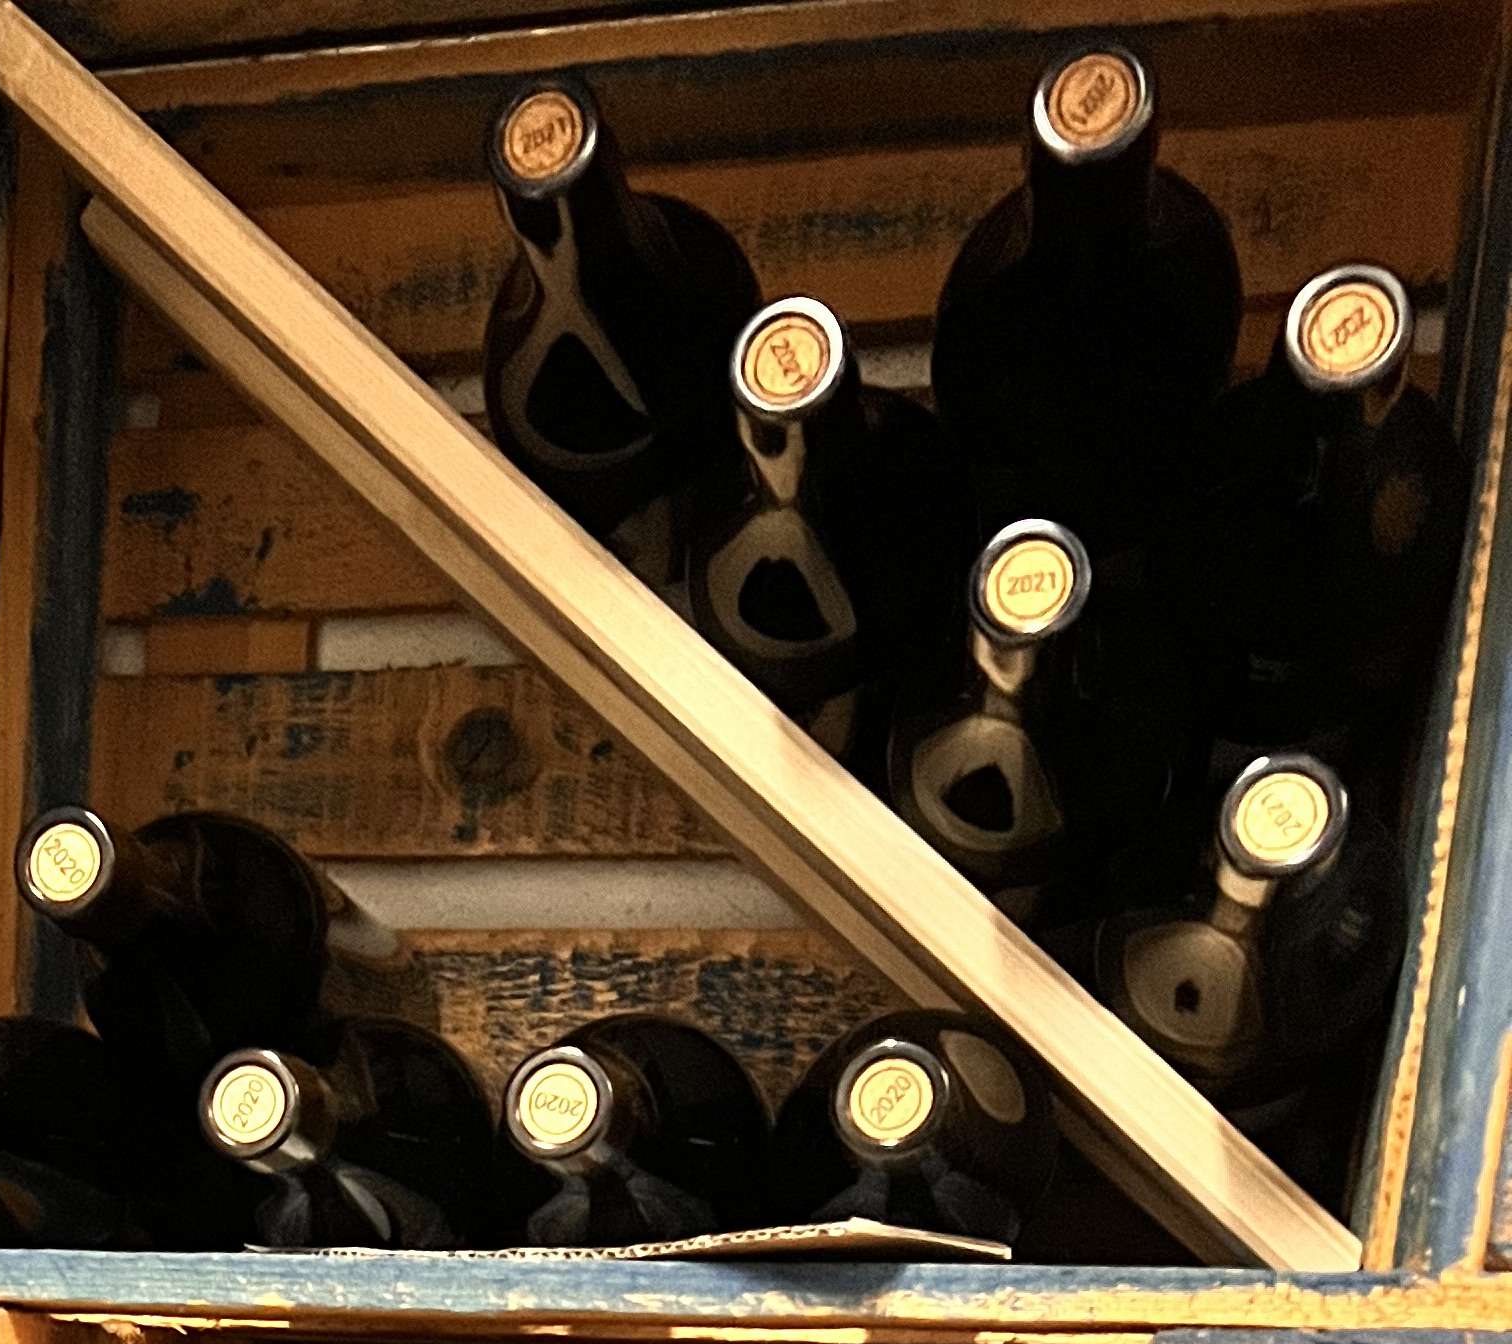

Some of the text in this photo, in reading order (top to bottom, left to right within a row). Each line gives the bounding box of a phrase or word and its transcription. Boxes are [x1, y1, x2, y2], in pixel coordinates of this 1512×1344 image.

[1006, 570, 1058, 596] 2021
[43, 836, 86, 885] 2020
[230, 1077, 266, 1128] 2020
[868, 1075, 914, 1123] 2020
